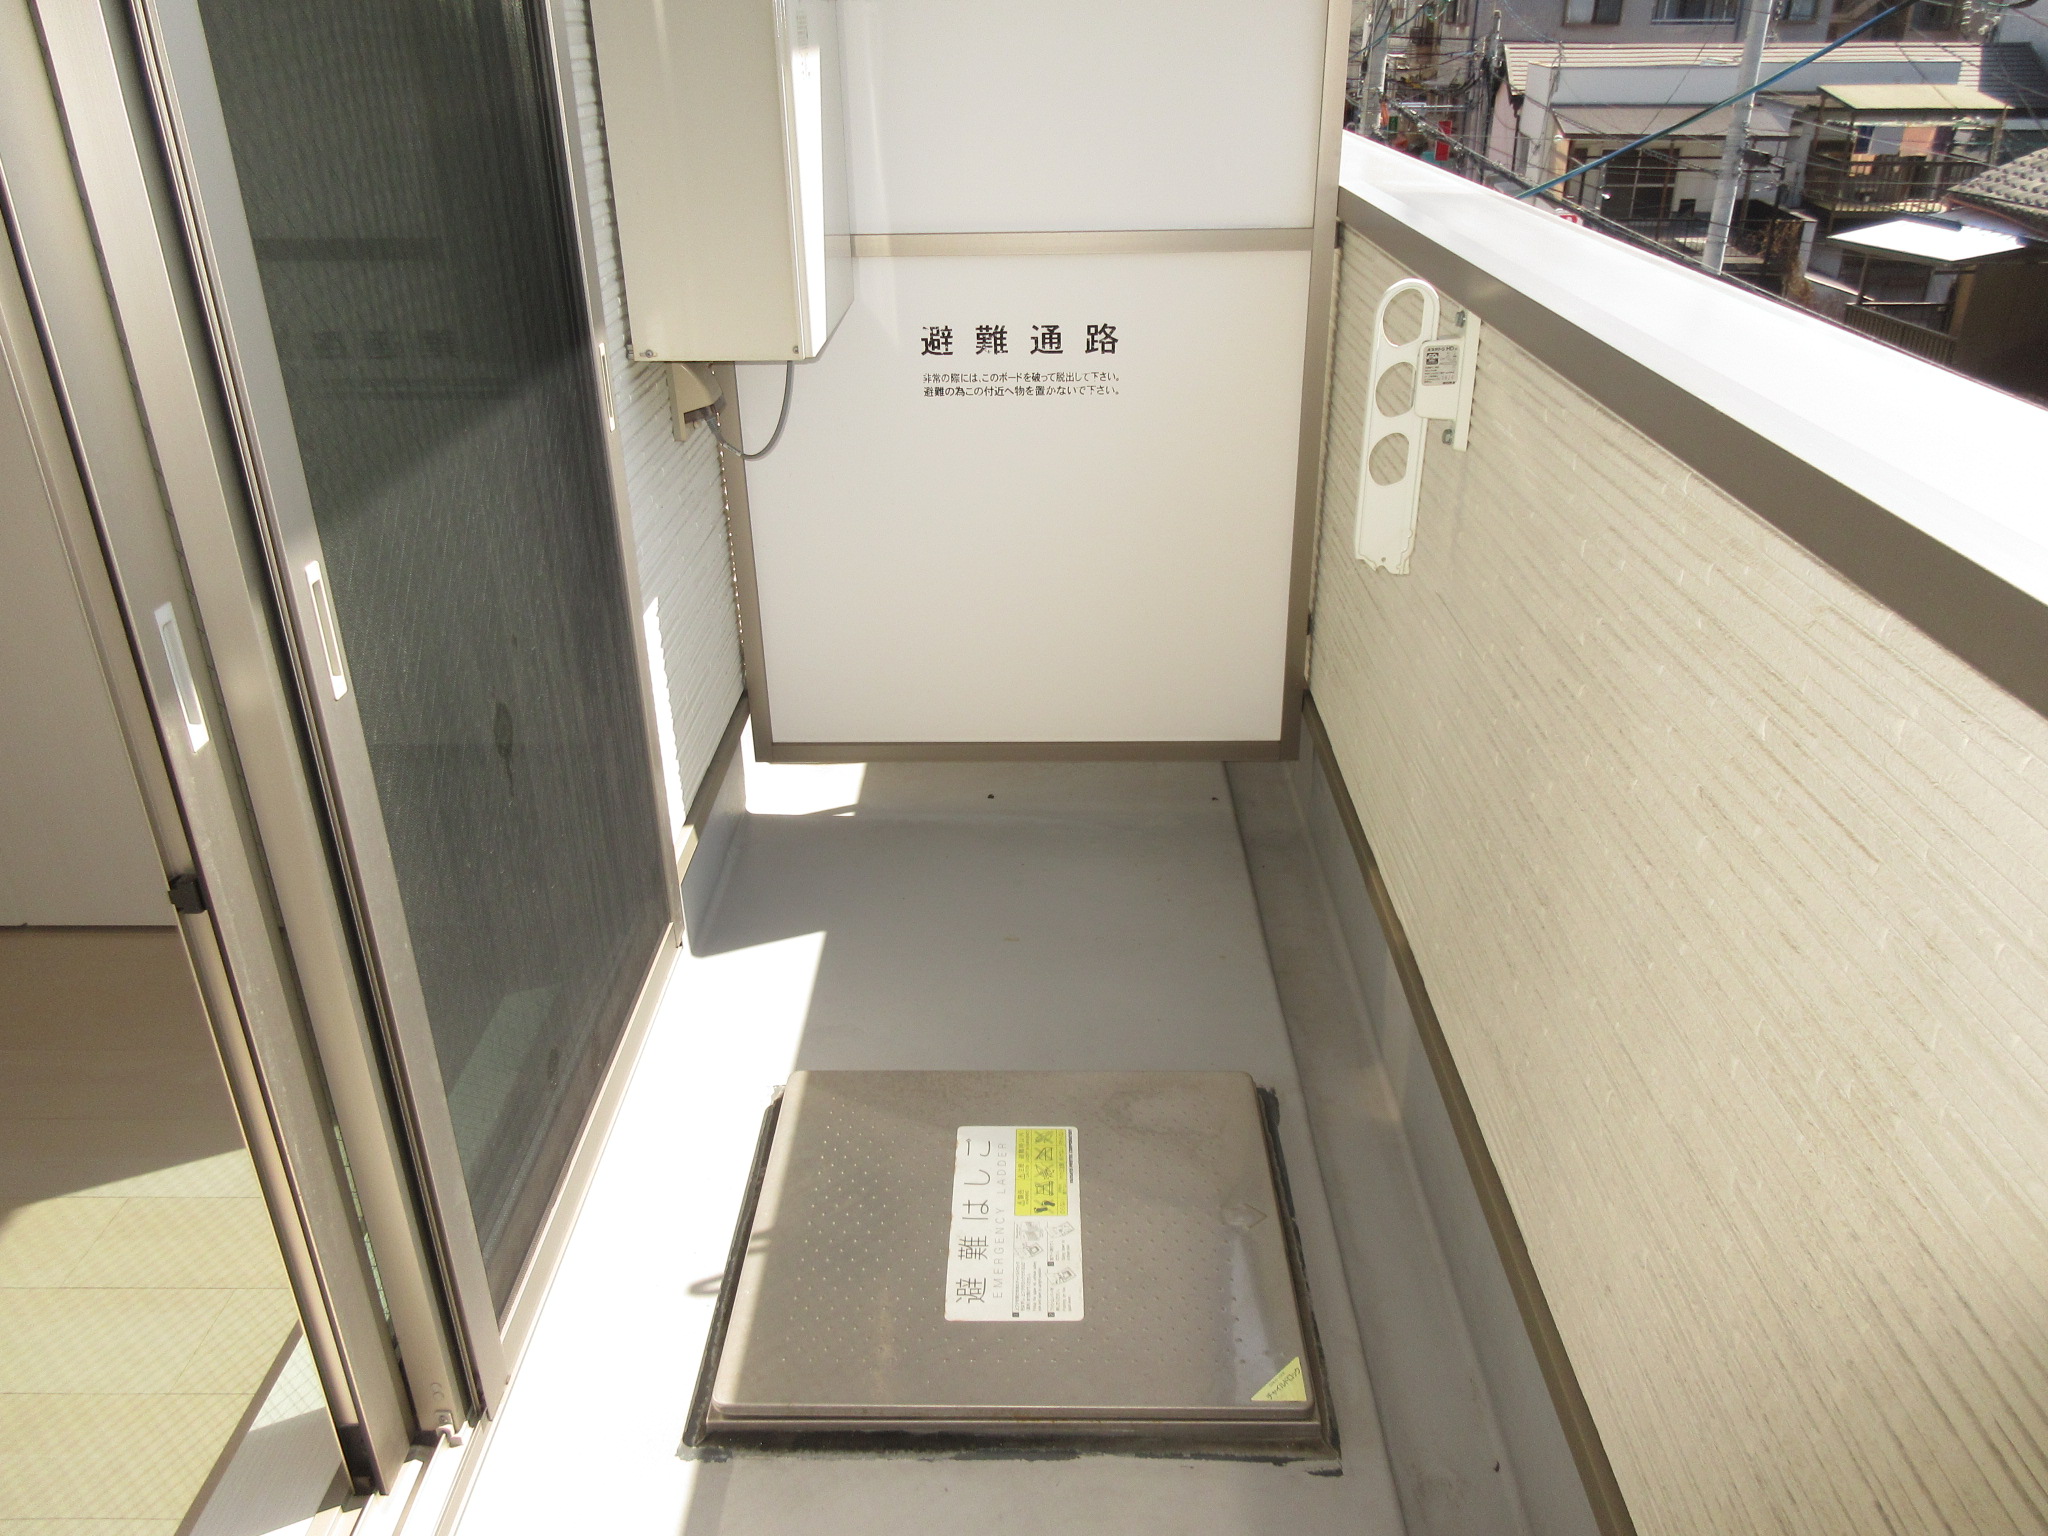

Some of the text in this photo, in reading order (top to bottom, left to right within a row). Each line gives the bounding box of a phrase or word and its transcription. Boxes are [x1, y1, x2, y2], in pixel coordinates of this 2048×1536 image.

[920, 323, 1119, 356] 避難通路
[923, 385, 1120, 397] 避難の為この付近へ物を置かないで下さい。
[955, 1138, 992, 1304] 避難はしご
[992, 1143, 1008, 1299] EMERGENCY LADDER
